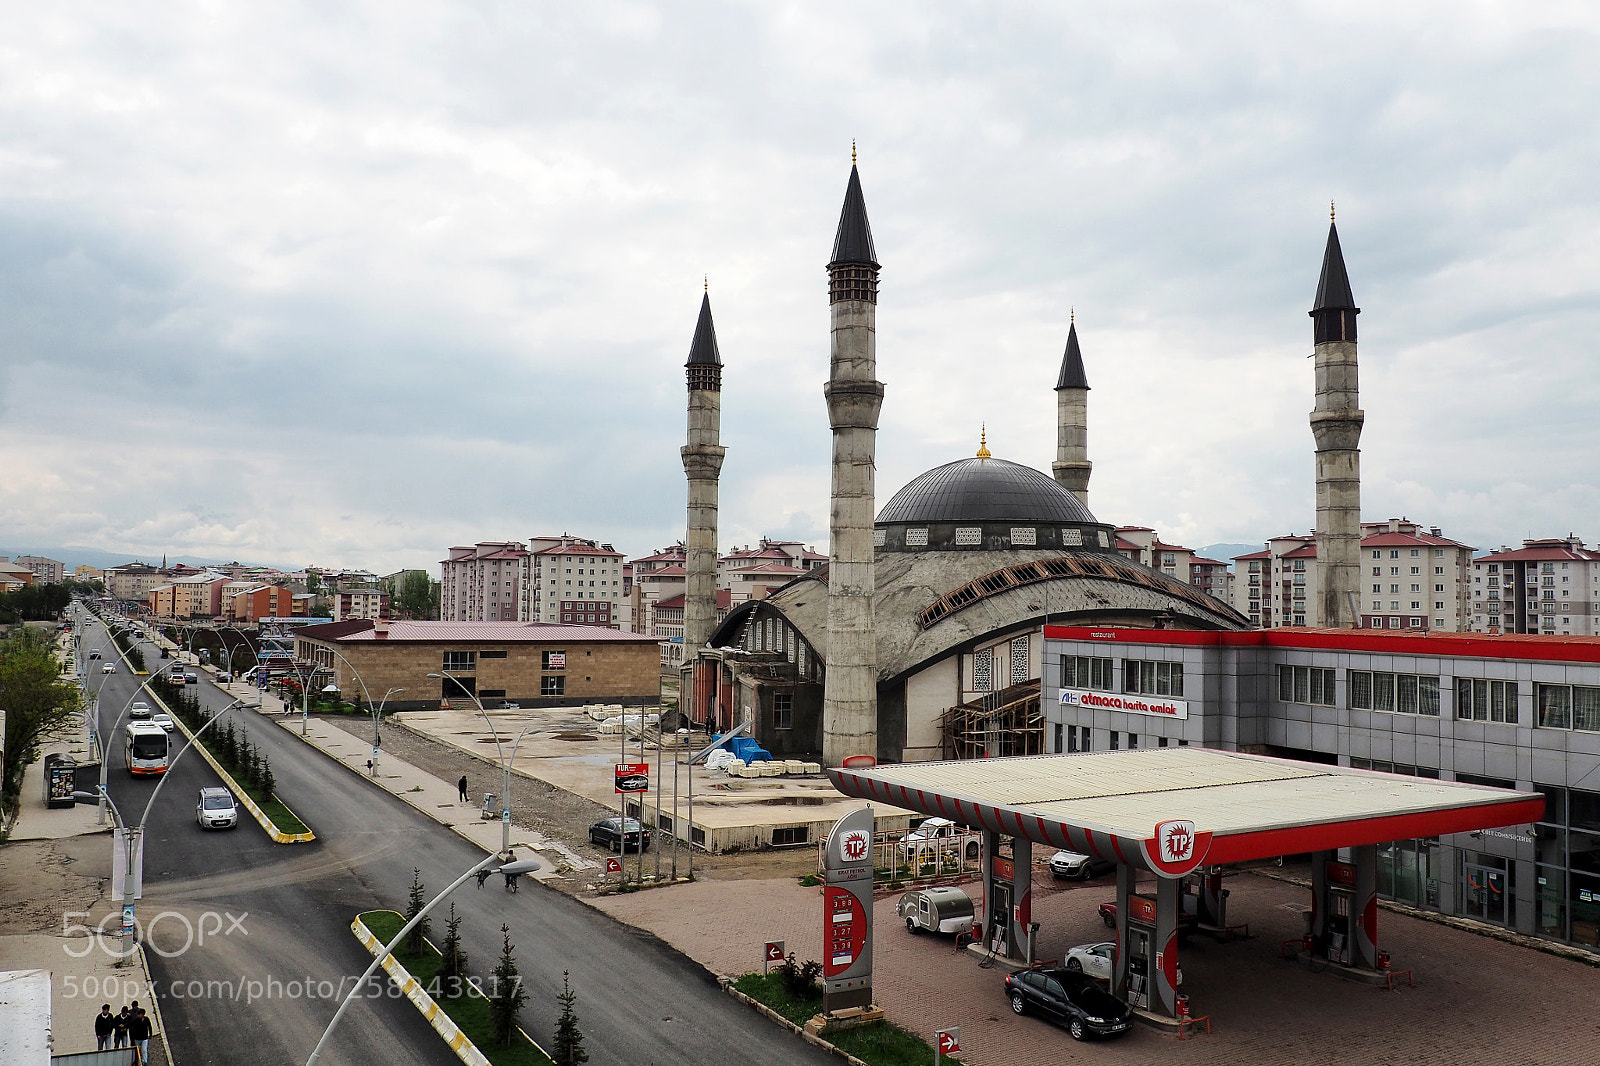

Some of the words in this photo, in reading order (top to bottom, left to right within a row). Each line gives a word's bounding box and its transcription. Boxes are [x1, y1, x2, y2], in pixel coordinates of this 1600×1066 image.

[1090, 631, 1116, 639] restaurant
[1081, 692, 1122, 709] atmaca
[1123, 699, 1148, 712] harita
[1150, 703, 1177, 715] emlak
[849, 840, 864, 854] TP
[1171, 834, 1188, 852] TP
